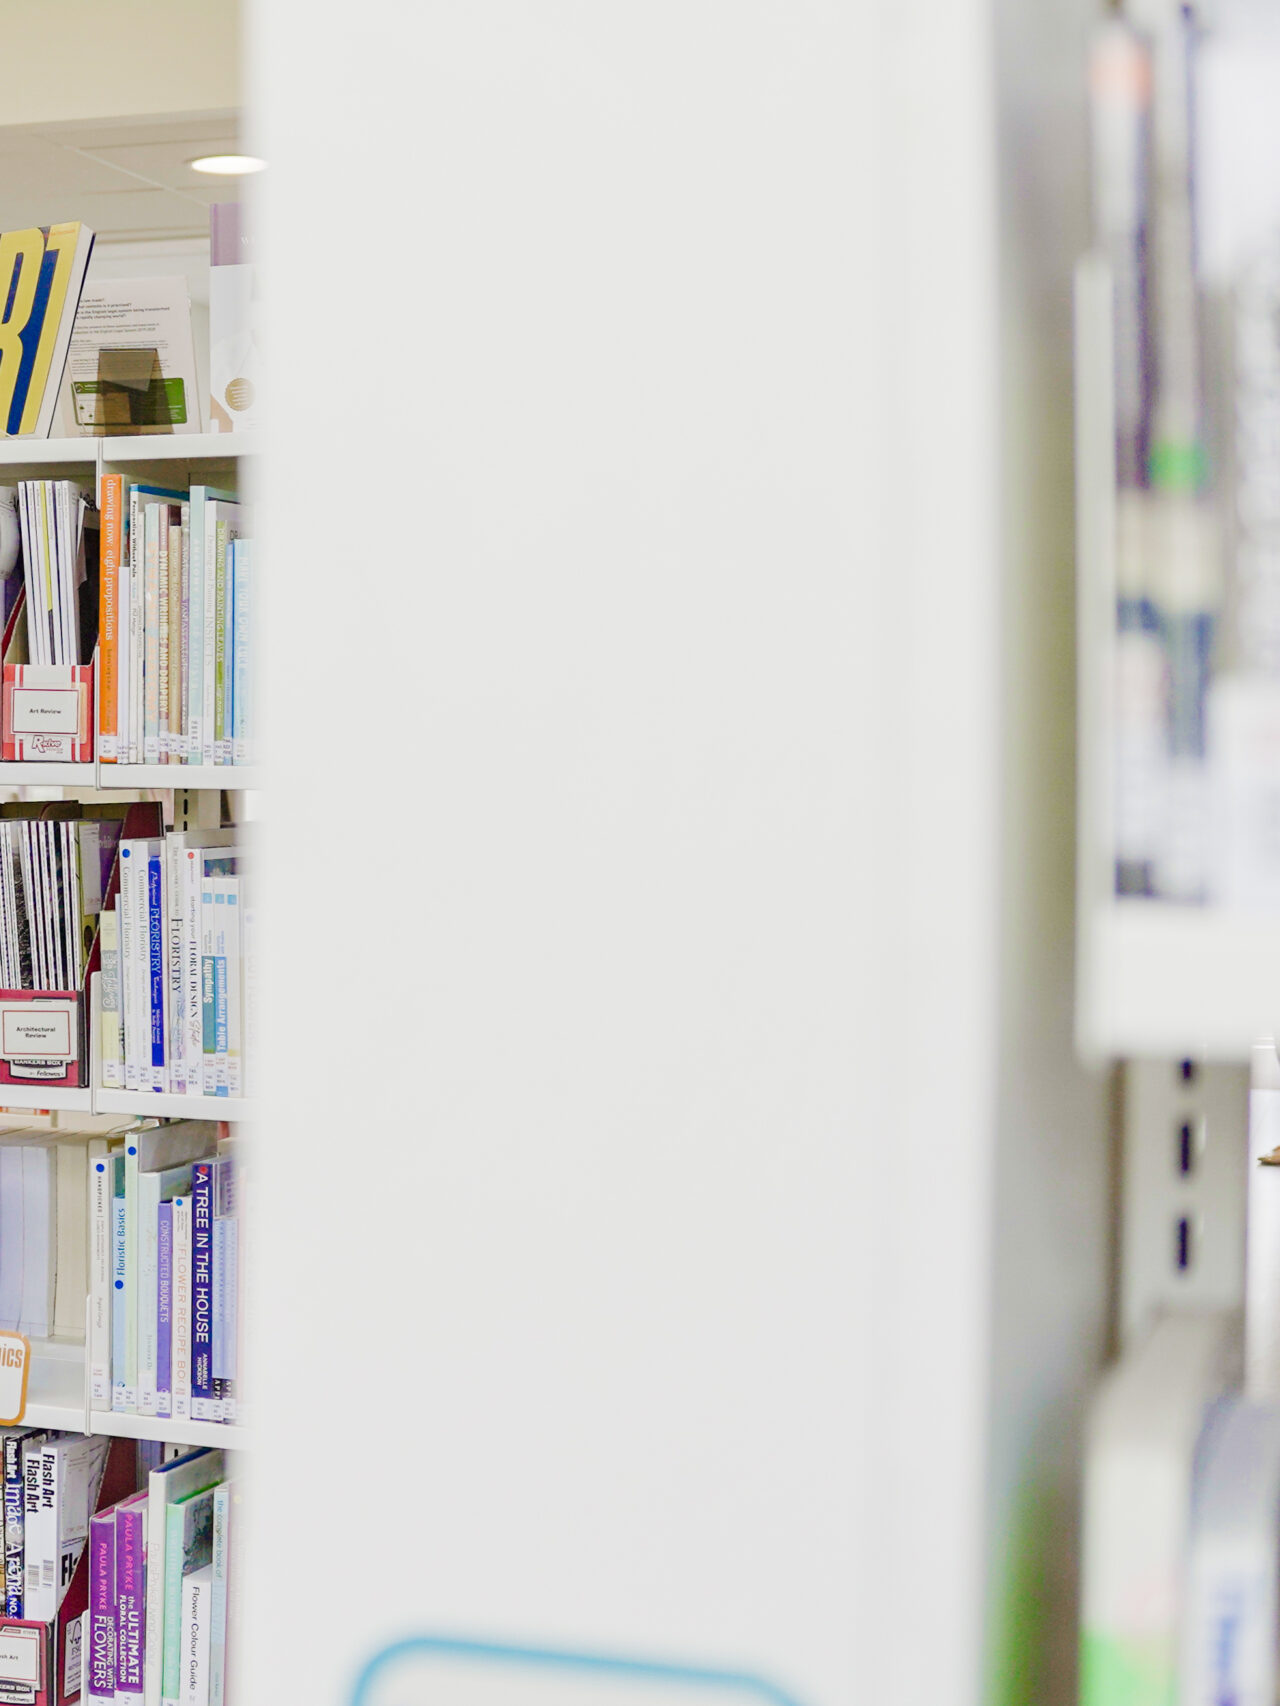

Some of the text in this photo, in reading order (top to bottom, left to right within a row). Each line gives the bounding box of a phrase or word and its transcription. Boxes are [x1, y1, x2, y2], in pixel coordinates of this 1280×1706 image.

[103, 479, 116, 640] drawing now: eight propositions
[150, 908, 160, 974] FLORISTRY
[171, 918, 183, 994] FLORISTRY
[203, 959, 214, 1003] Sympathy
[116, 1208, 125, 1277] Floristic Basics
[196, 1172, 209, 1343] A TREE IN THE HOUSE
[26, 1460, 39, 1513] Flash Art
[41, 1454, 56, 1508] Flash Art
[125, 1514, 133, 1590] PAULA PRYKE
[94, 1615, 106, 1688] FLOWERS
[128, 1611, 139, 1684] ULTIMATE
[189, 1586, 200, 1690] Flower Colour Guide
